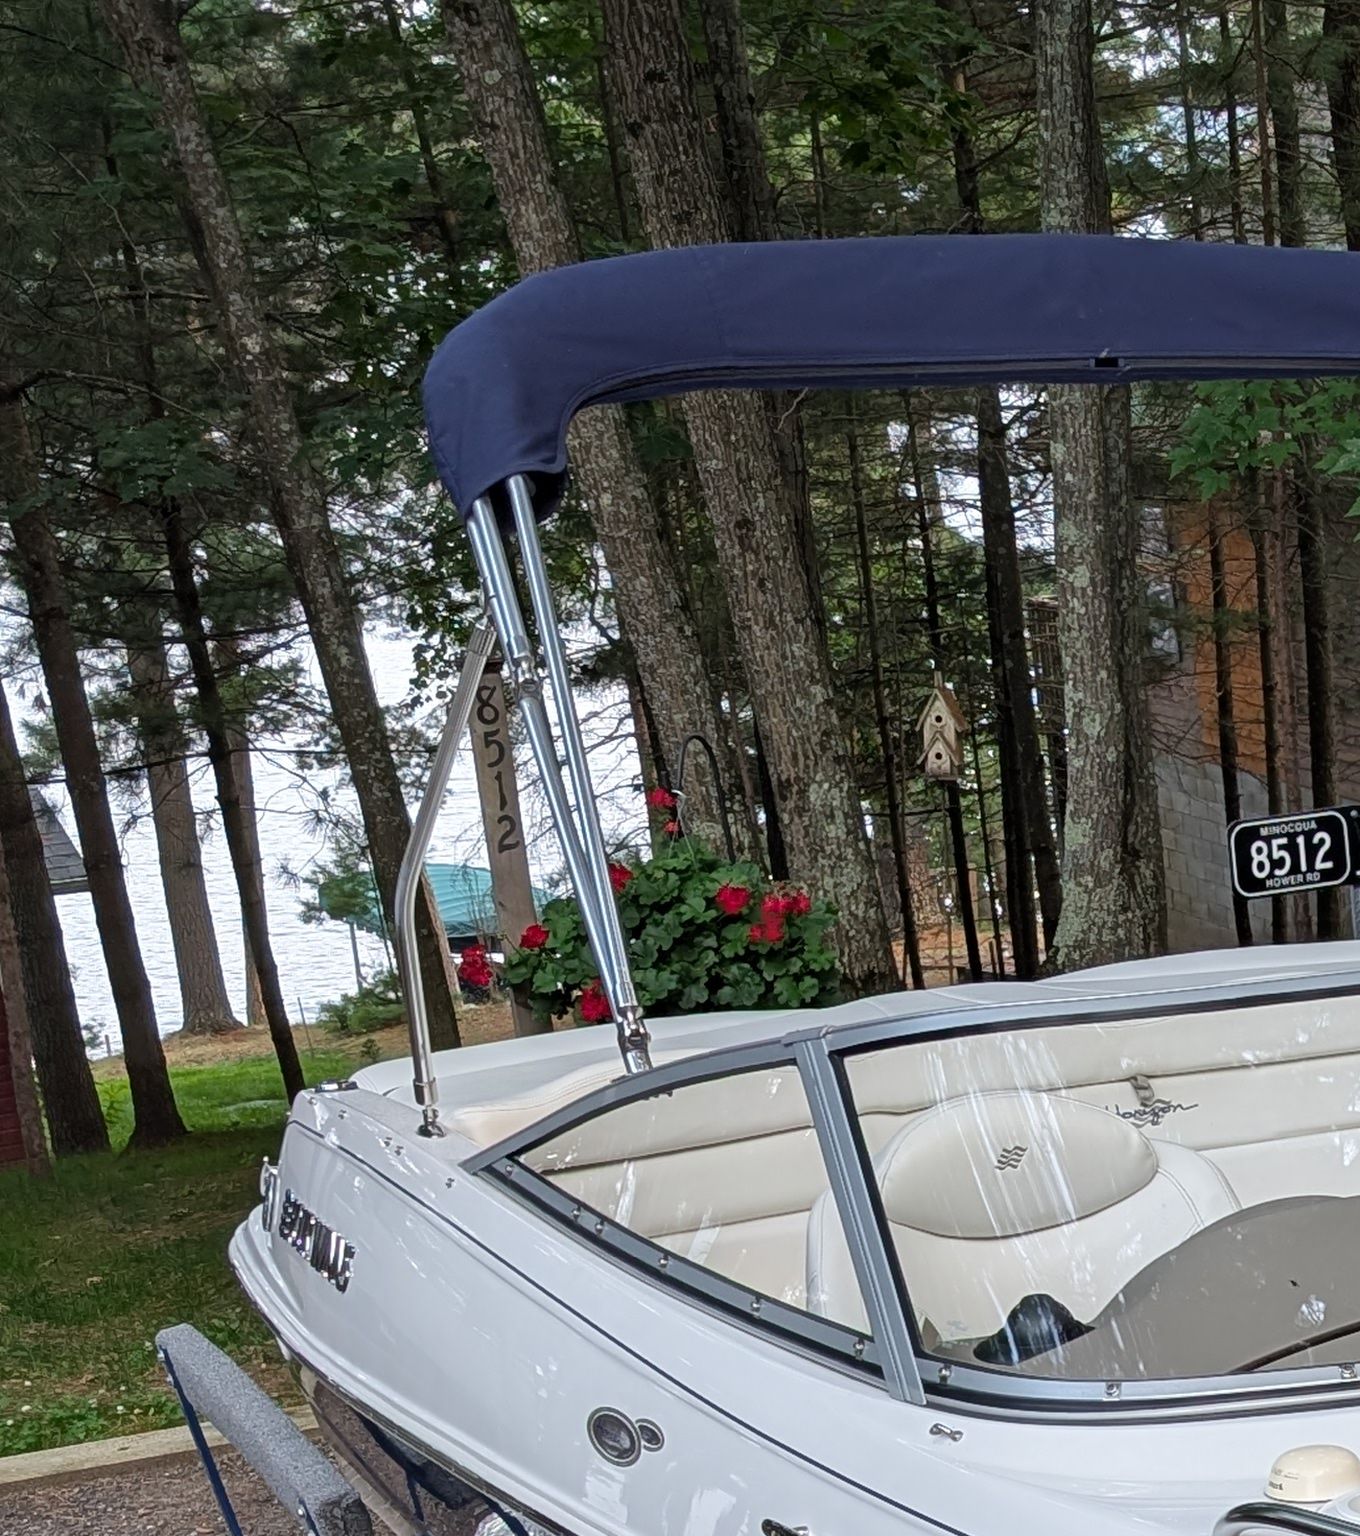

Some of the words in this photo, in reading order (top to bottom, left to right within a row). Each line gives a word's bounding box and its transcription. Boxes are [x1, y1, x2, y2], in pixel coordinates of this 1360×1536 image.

[475, 685, 521, 854] 8512
[1259, 820, 1318, 837] MINOCQUA
[1250, 830, 1334, 879] 8512
[1265, 874, 1304, 888] HOWER
[1306, 871, 1321, 882] RD
